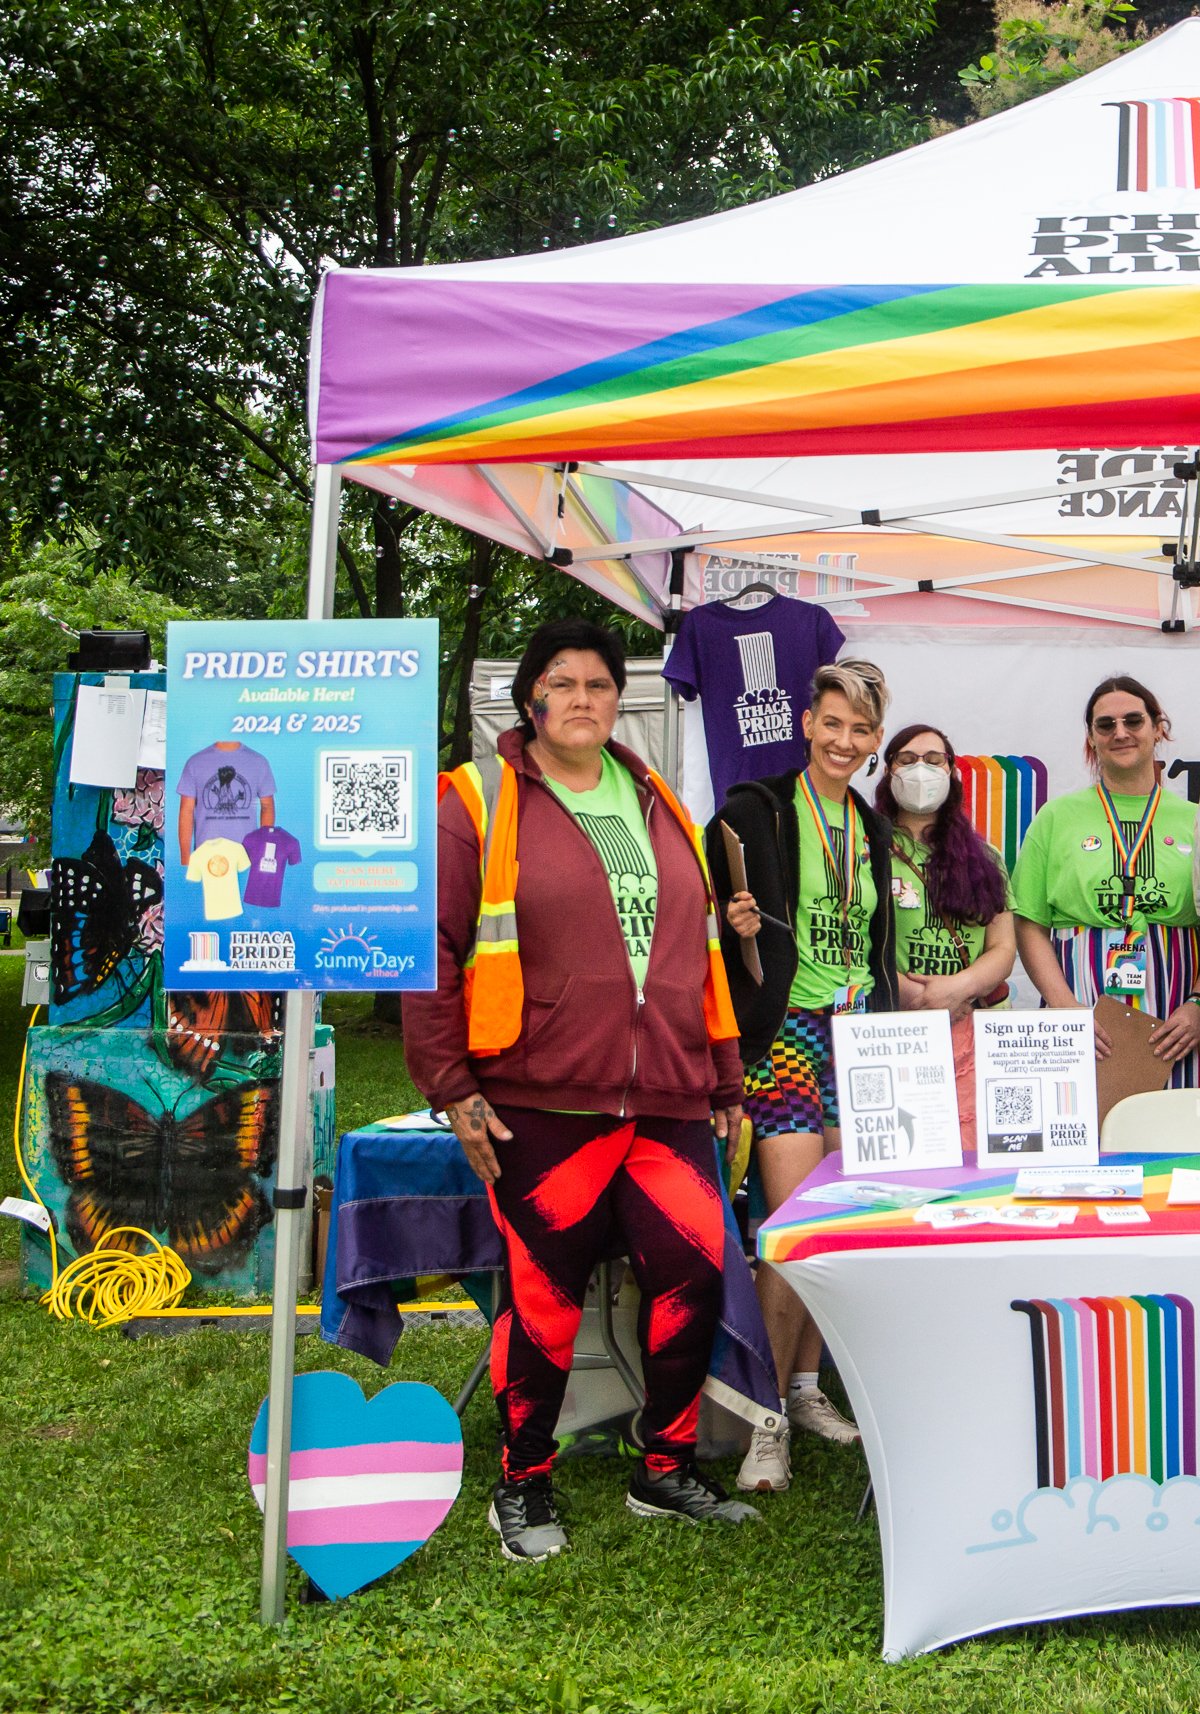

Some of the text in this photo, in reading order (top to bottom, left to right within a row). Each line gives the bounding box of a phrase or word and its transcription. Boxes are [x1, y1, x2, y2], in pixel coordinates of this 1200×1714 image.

[183, 650, 419, 679] PRIDE SHIRTS
[238, 687, 355, 703] Available Here!
[736, 702, 792, 720] ITHACA
[231, 713, 361, 734] 2024 & 2025
[738, 713, 793, 735] PRIDE
[743, 728, 793, 747] ALLIANCE
[232, 933, 293, 944] ITHACA
[232, 946, 293, 959] PRIDE
[1109, 943, 1145, 952] SERENA
[231, 960, 293, 969] ALLIANCE
[315, 951, 415, 972] Sunny Days
[909, 956, 962, 975] PRID
[373, 968, 399, 977] Ithaca
[836, 1001, 864, 1014] SARAH
[851, 1026, 928, 1039] Volunteer
[985, 1022, 1086, 1036] Sign up for our
[857, 1041, 929, 1056] with IPA!
[998, 1036, 1074, 1050] mailing list
[1031, 1050, 1076, 1058] opportunities
[916, 1071, 944, 1079] PRIDE
[1030, 1065, 1069, 1073] Community
[855, 1116, 895, 1133] SCAN
[1002, 1134, 1028, 1144] SCAN
[1050, 1130, 1087, 1139] PRIDE
[857, 1134, 897, 1162] ME!
[1008, 1142, 1022, 1151] ME
